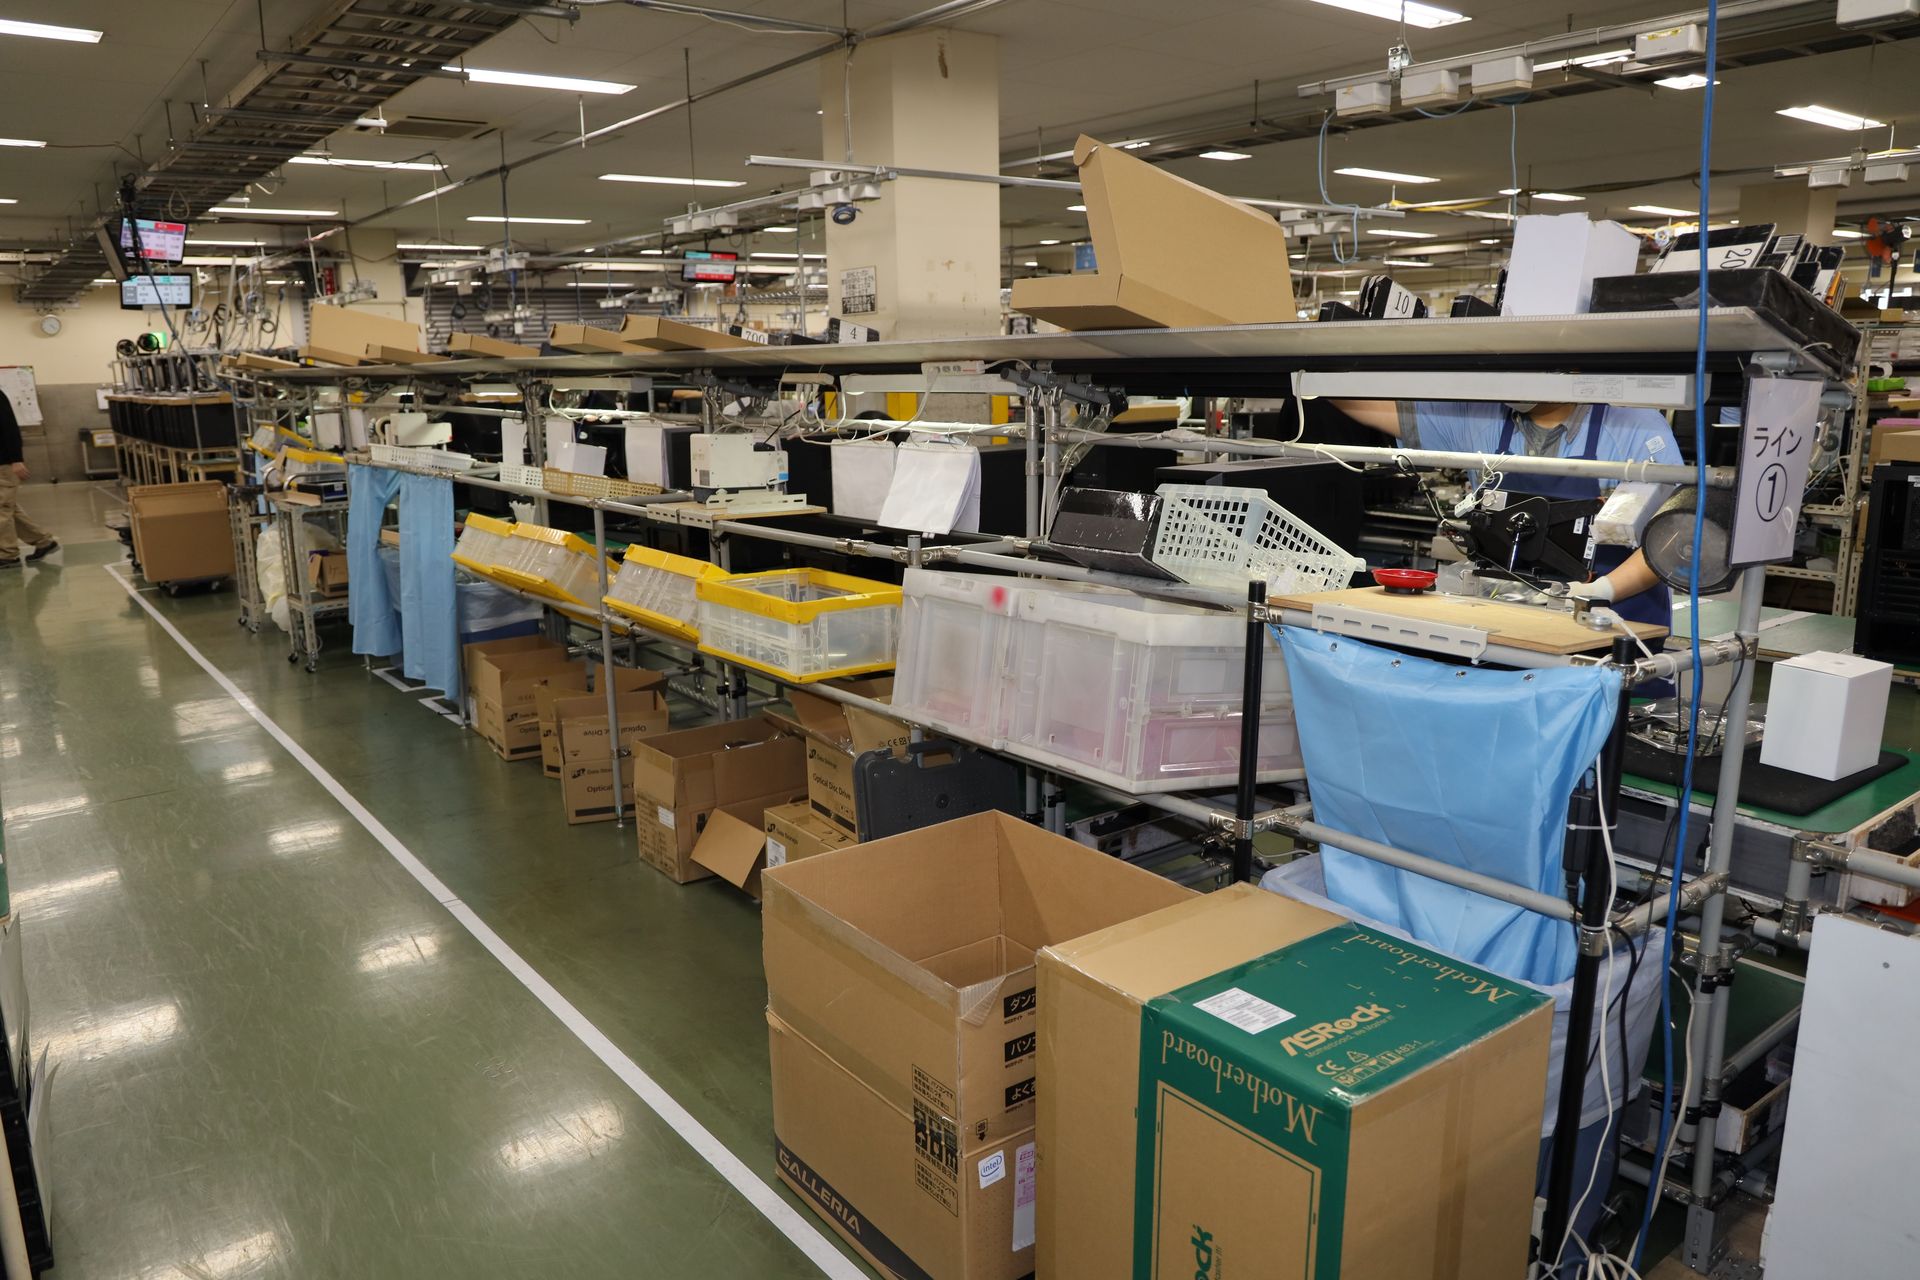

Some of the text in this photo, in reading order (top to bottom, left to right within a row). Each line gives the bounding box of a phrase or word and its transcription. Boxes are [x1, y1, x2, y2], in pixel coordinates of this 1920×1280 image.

[1719, 248, 1752, 269] 20
[1395, 291, 1410, 314] 10
[745, 330, 766, 344] 700
[850, 327, 857, 340] 4
[1754, 426, 1802, 458] ライン
[587, 783, 613, 793] Optical
[812, 772, 851, 801] Optical Disc Drive
[1343, 933, 1519, 1005] Motherboard
[1280, 1003, 1391, 1057] ASRock
[1161, 1030, 1324, 1146] Motherboard
[779, 1148, 862, 1235] GALLERIA
